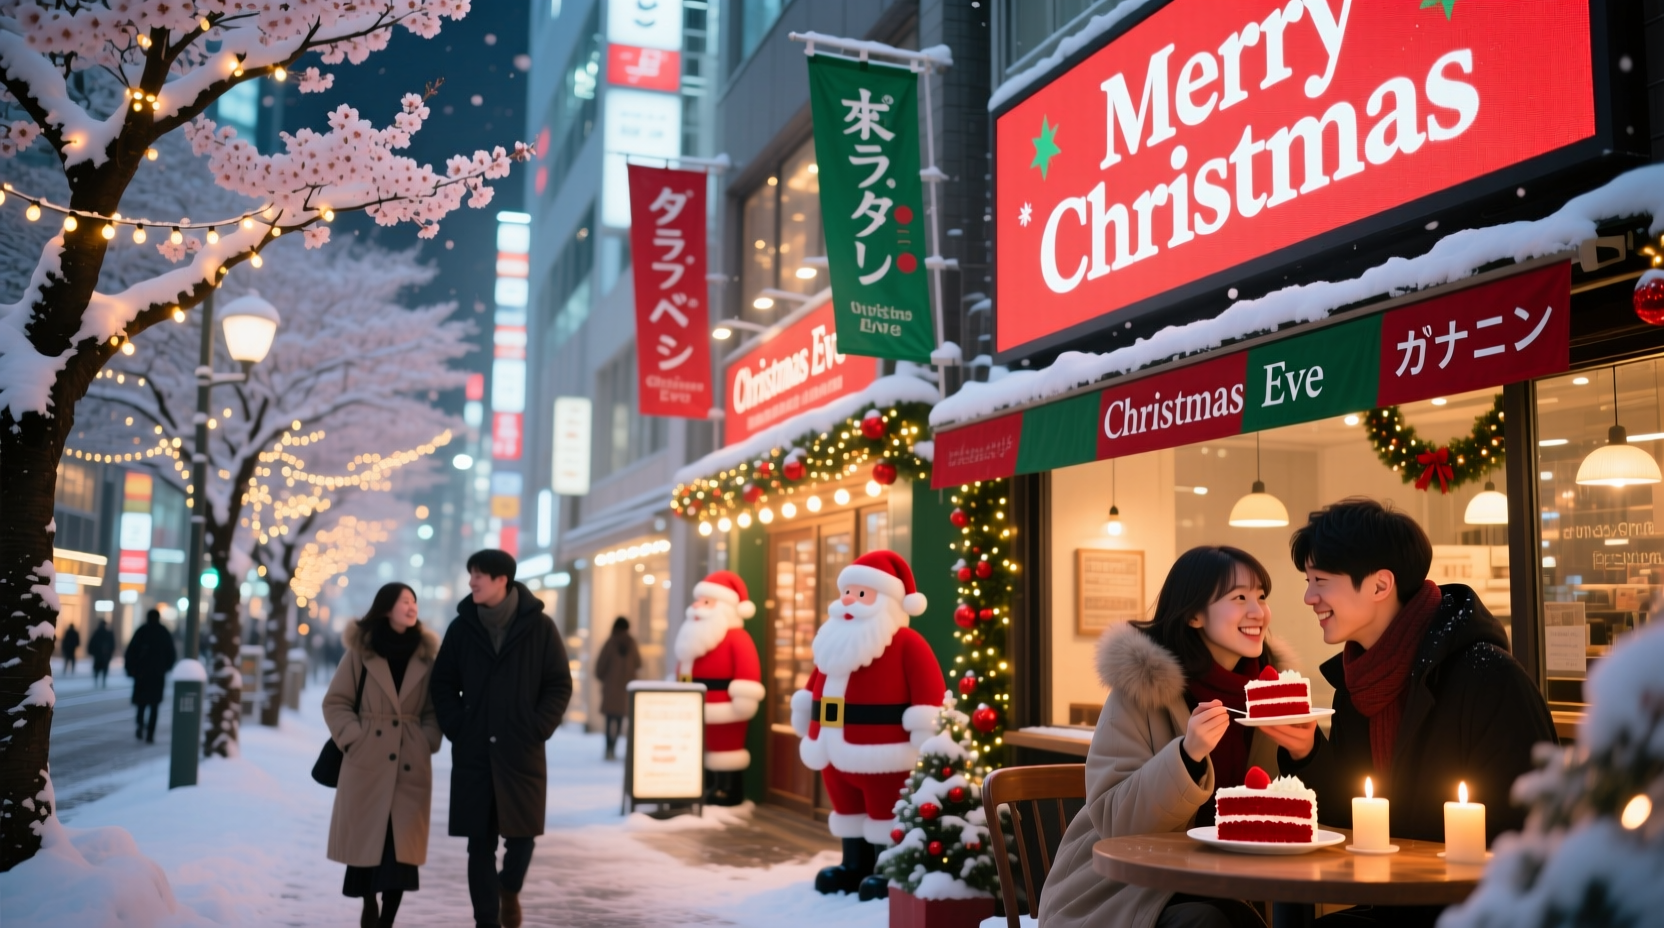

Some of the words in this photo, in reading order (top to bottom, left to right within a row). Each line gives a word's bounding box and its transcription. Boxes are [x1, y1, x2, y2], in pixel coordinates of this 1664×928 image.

[1100, 0, 1352, 170] Merry
[1041, 49, 1480, 293] Christmas
[1104, 383, 1244, 440] Christmas
[1261, 361, 1324, 408] Eve
